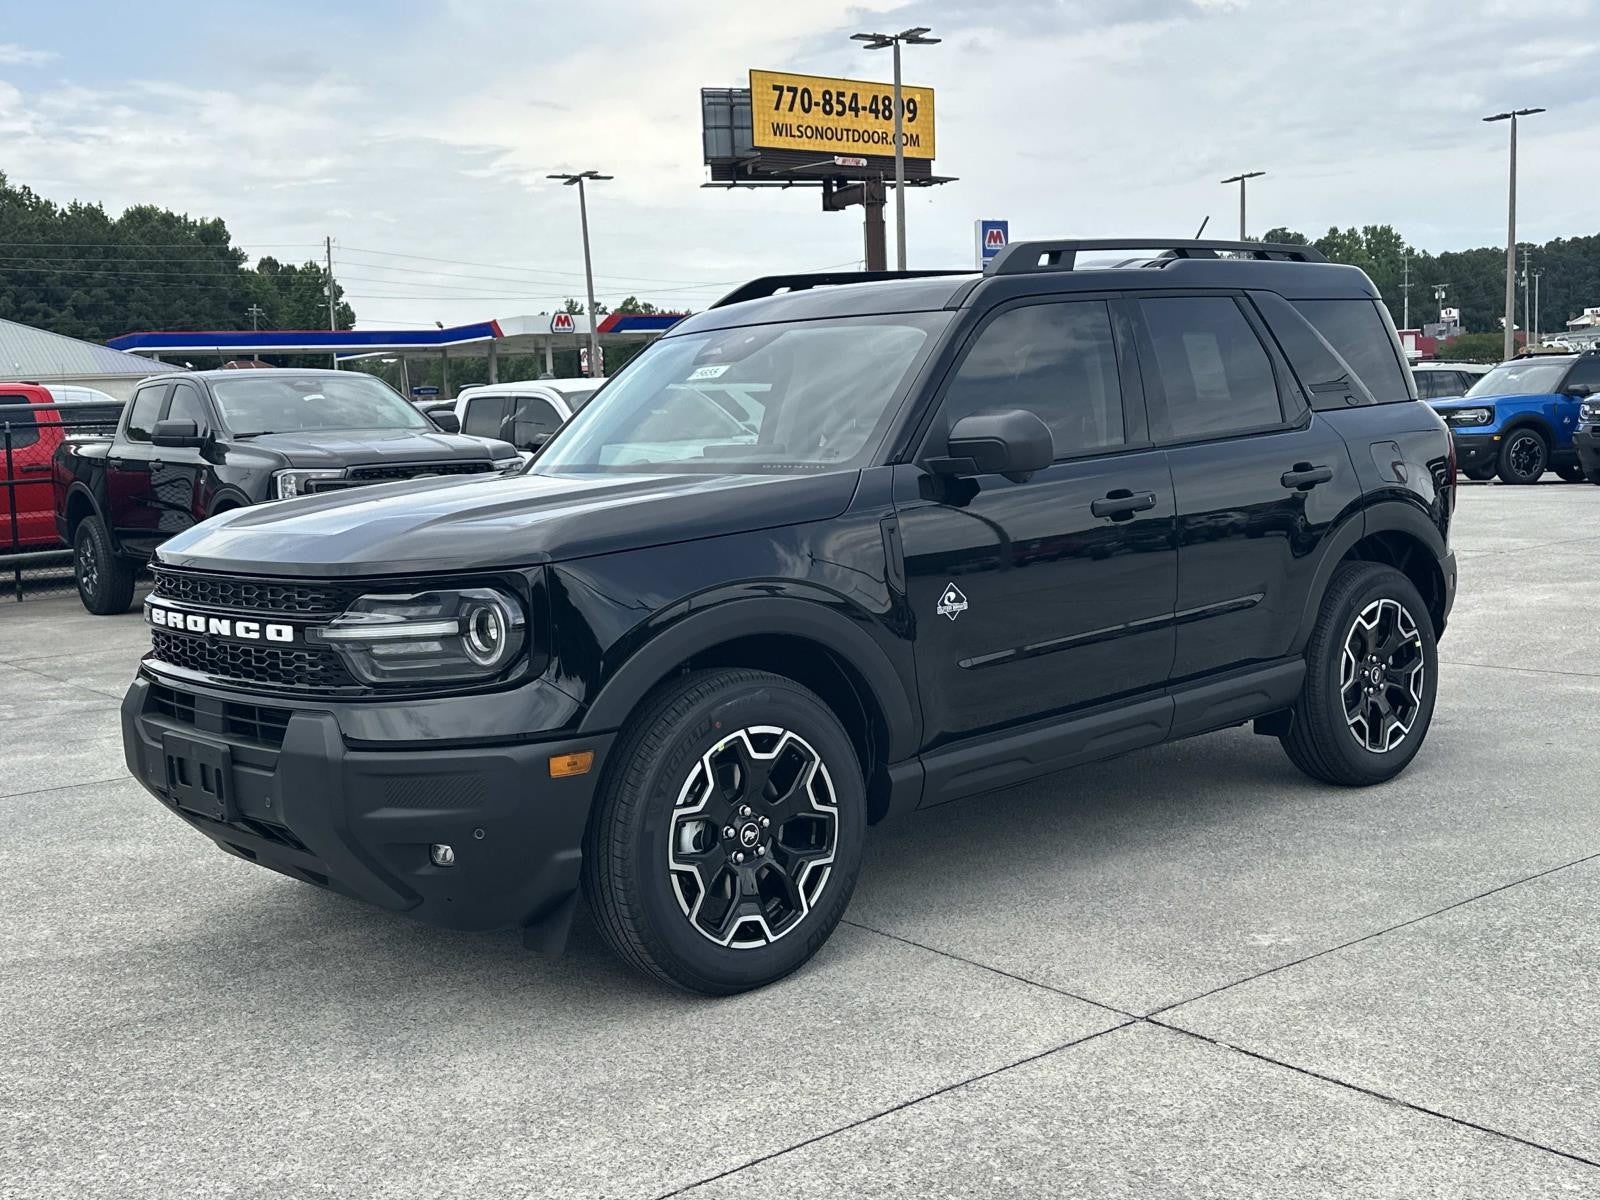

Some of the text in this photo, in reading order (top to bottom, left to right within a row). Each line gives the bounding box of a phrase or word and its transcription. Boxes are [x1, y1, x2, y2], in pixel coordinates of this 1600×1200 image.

[987, 230, 1004, 244] M
[555, 315, 572, 327] M
[151, 607, 294, 643] BRONCO
